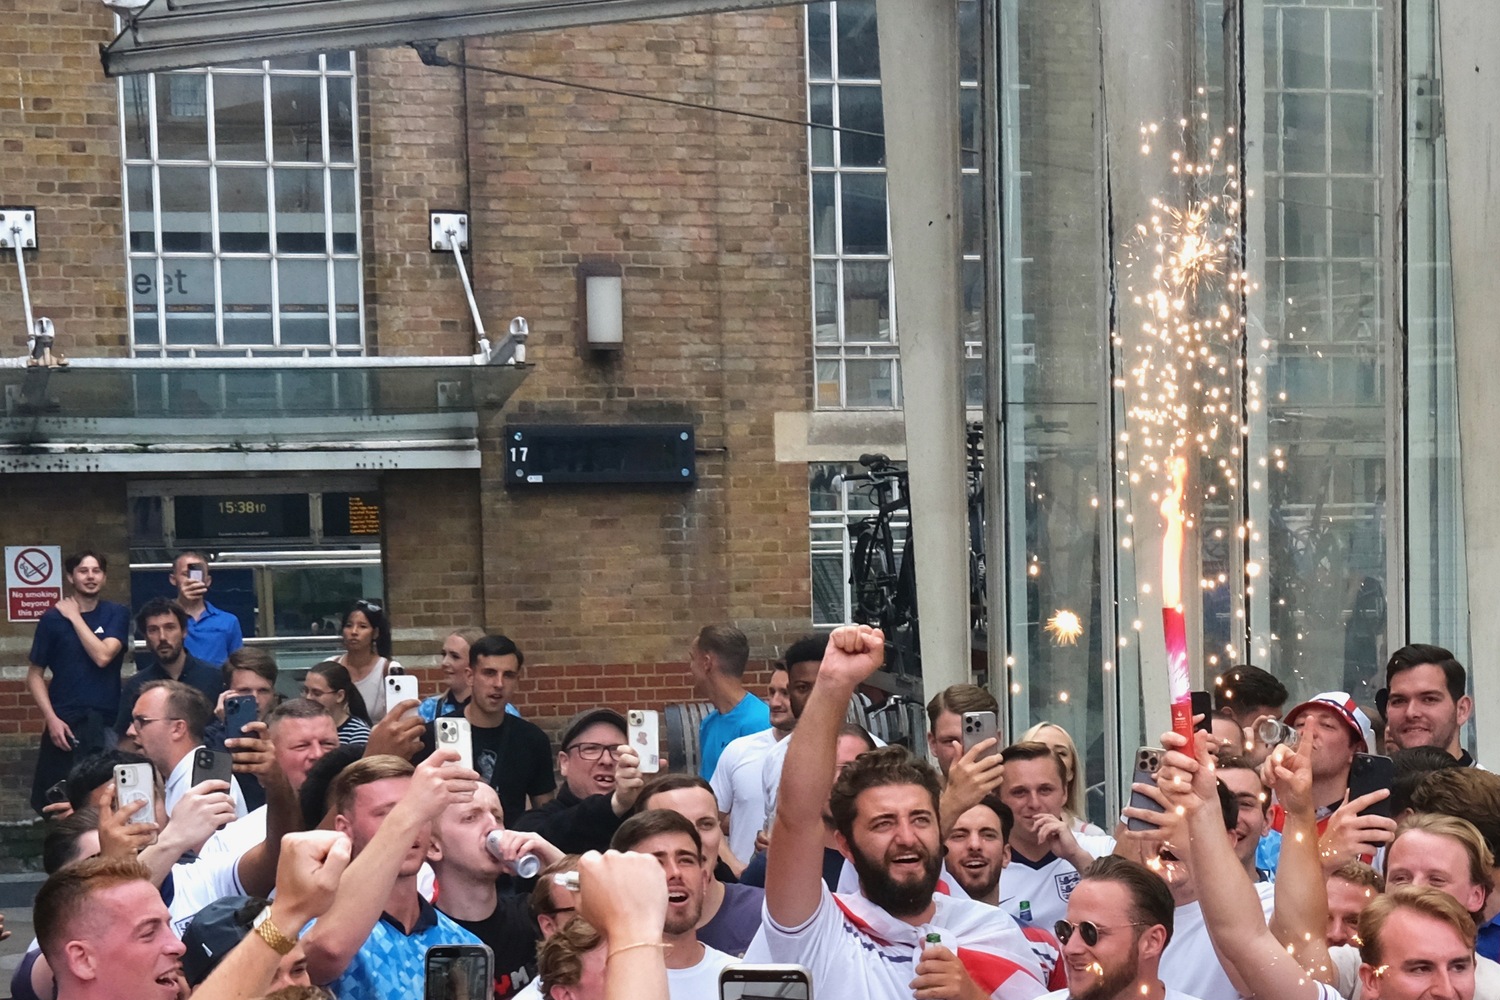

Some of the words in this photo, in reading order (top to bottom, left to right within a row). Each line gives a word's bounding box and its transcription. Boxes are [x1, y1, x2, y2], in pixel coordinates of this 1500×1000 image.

[510, 447, 528, 462] 17
[25, 591, 58, 599] smoking
[21, 600, 50, 608] beyond
